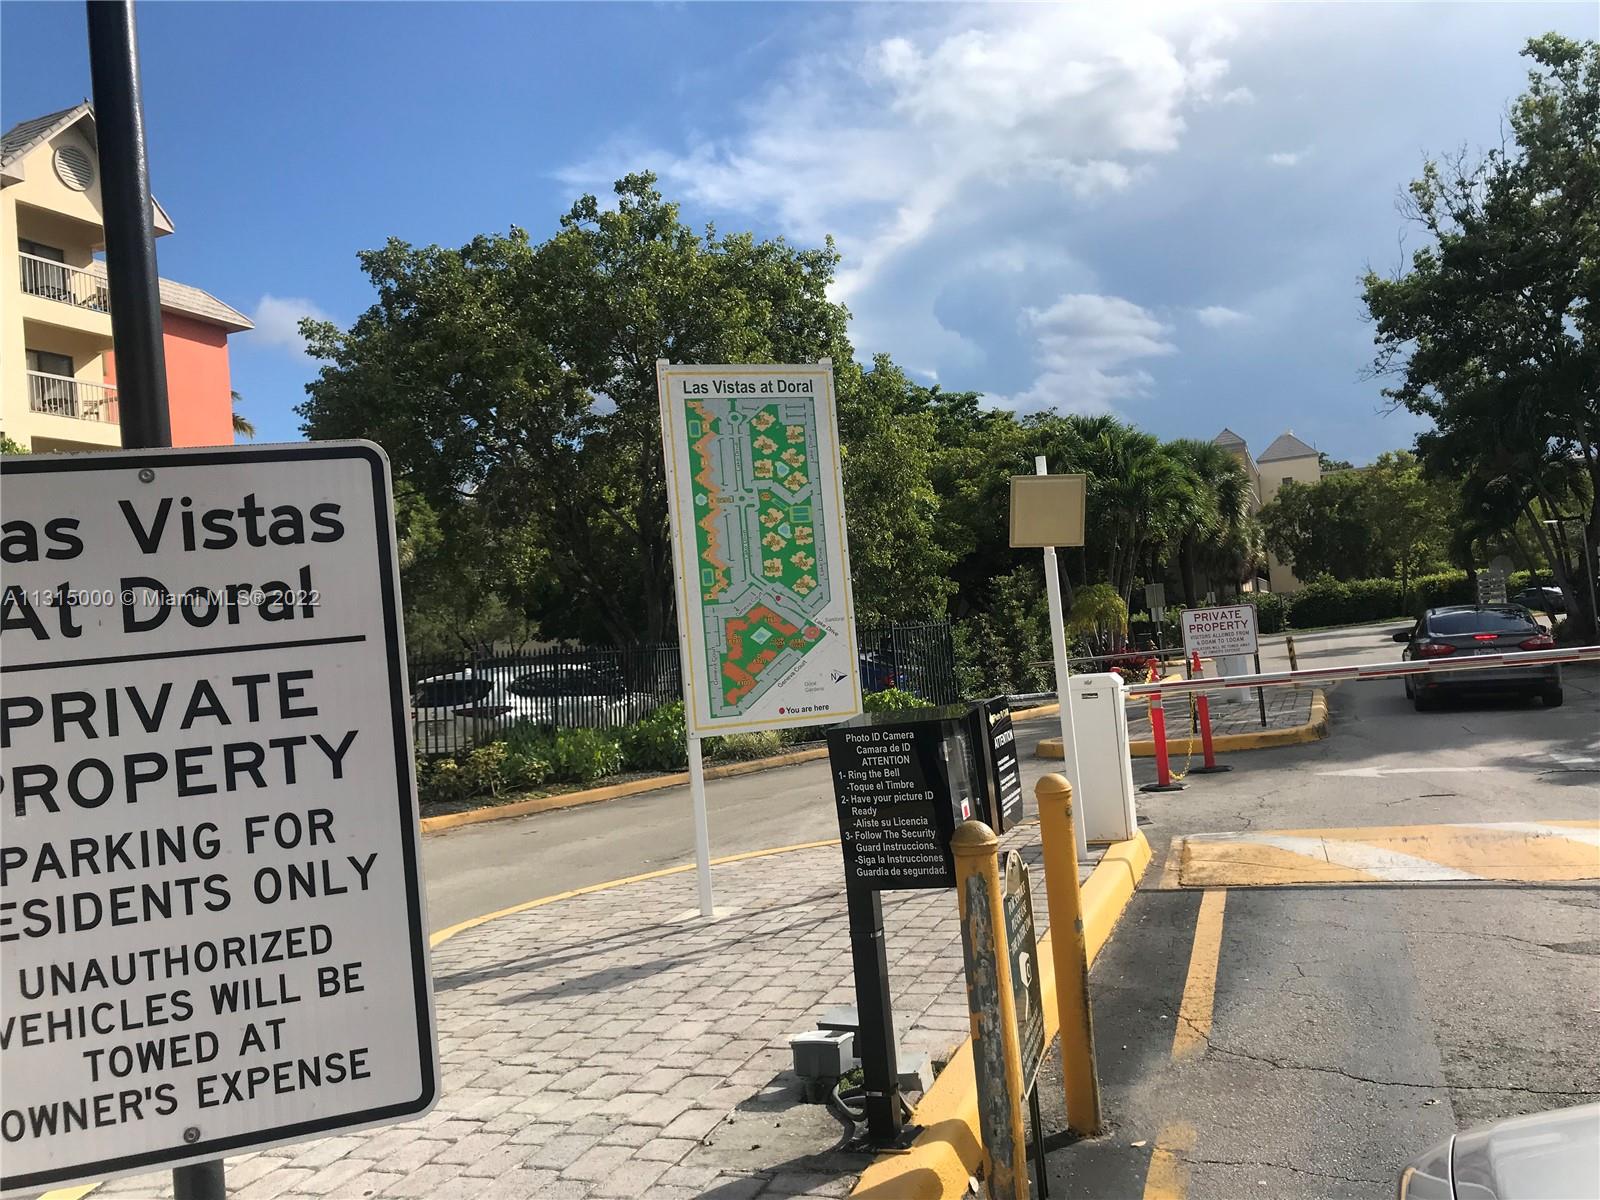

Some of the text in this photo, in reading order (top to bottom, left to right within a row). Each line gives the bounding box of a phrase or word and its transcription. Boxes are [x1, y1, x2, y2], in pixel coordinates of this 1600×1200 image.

[683, 379, 813, 394] Las Vistas at Doral
[0, 492, 345, 563] as Vistas
[0, 564, 315, 640] At Doral
[1194, 610, 1241, 622] PRIVATE
[1189, 619, 1248, 633] PROPERTY
[777, 660, 808, 688] Geneva Court
[830, 672, 837, 680] N
[0, 669, 318, 748] PRIVATE
[786, 706, 800, 715] You
[814, 704, 830, 712] here
[845, 731, 914, 743] Photo ID Camera
[856, 742, 911, 755] Camara de ID
[861, 755, 910, 767] ATTENTION
[0, 730, 359, 816] ROPERTY
[838, 767, 900, 780] 1- Ring the Bell
[846, 779, 914, 792] -Toque el Timbre
[841, 790, 934, 805] 2- Have your picture ID
[851, 806, 877, 817] Ready
[853, 816, 929, 828] -Aliste su Licencia
[845, 828, 936, 841] 3- Follow The Security
[0, 808, 336, 886] PARKING FOR
[856, 841, 937, 852] Guard Instruccions.
[878, 855, 886, 864] la
[887, 853, 944, 864] Instrucciones
[856, 865, 947, 878] Guardia de seguridad.
[0, 852, 378, 942] ESIDENTS ONLY
[19, 924, 333, 1000] UNAUTHORIZED
[0, 962, 365, 1050] VEHICLES WILL BE
[83, 1018, 286, 1082] TOWED AT
[1, 1048, 371, 1143] OWNER'S EXPENSE
